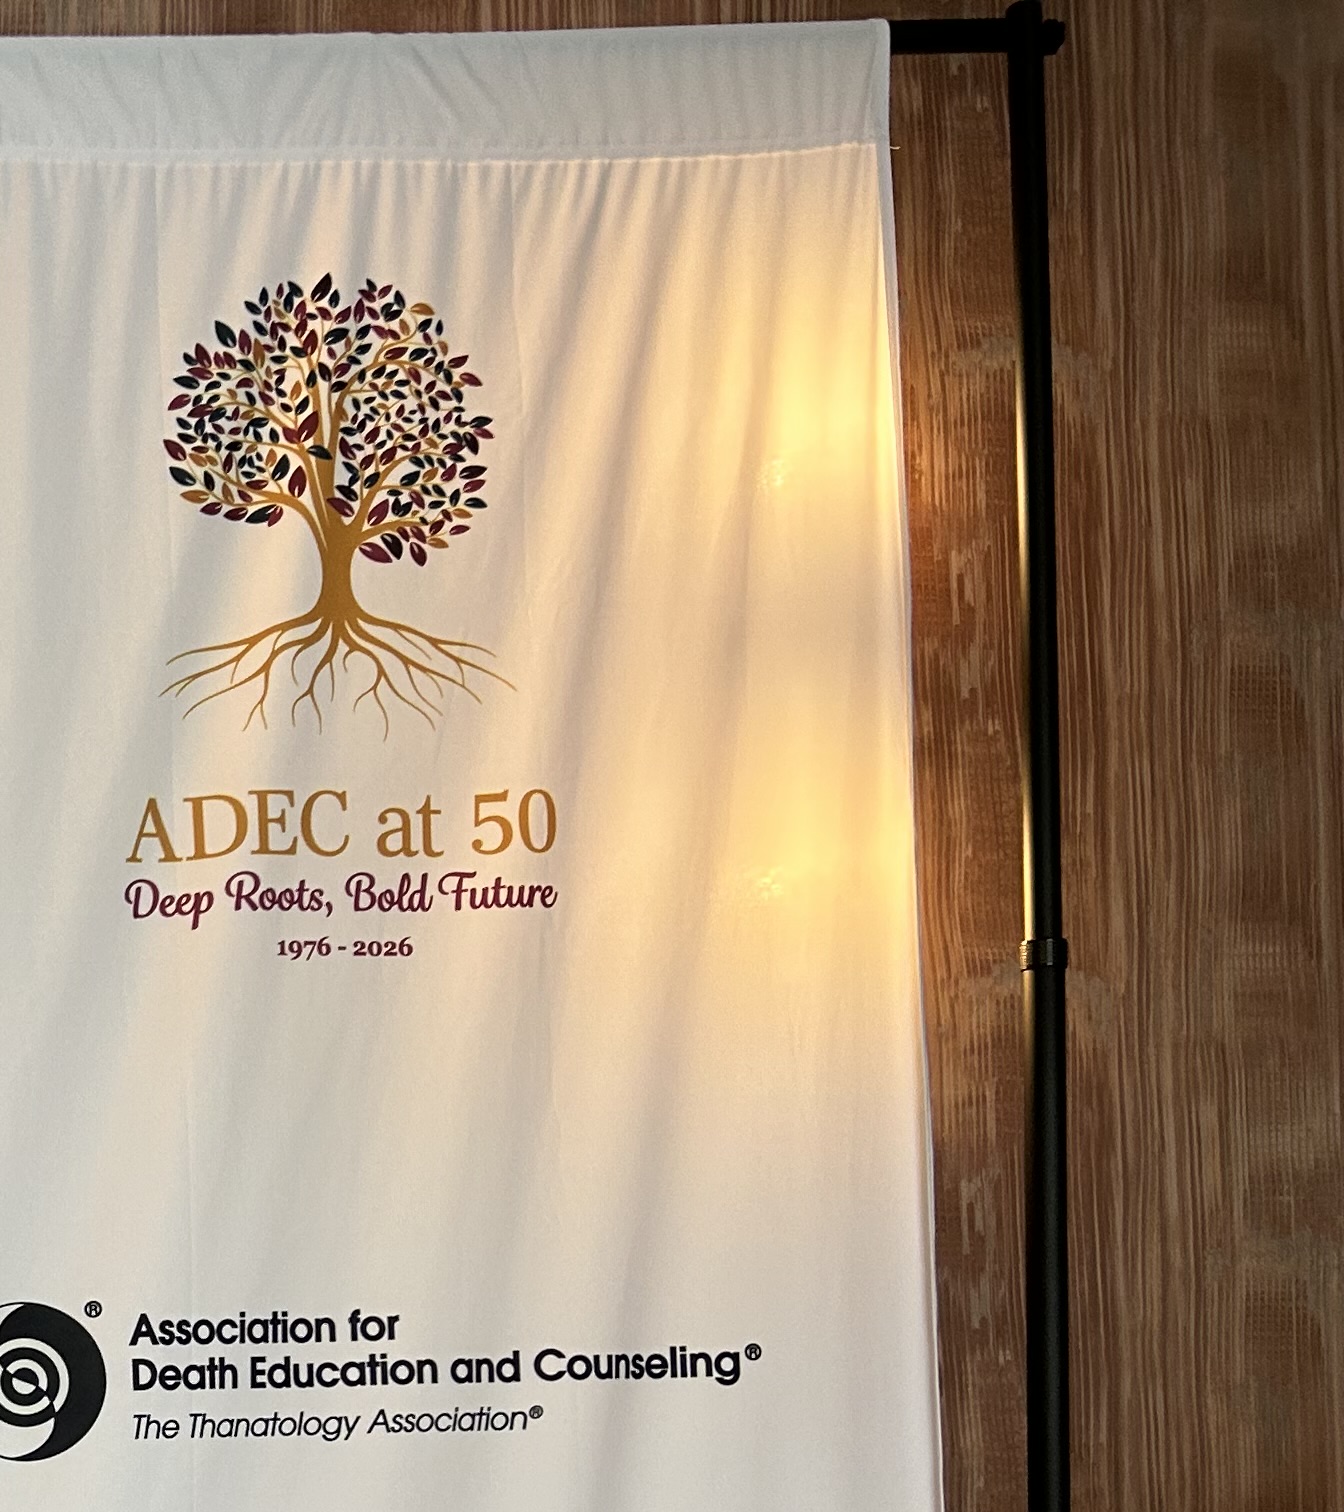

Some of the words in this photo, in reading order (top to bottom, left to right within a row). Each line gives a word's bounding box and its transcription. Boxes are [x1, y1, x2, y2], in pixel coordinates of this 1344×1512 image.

[126, 790, 349, 863] ADEC
[377, 795, 444, 858] at
[472, 789, 556, 855] 50
[124, 879, 214, 930] Deep
[225, 871, 333, 917] Roots,
[345, 872, 433, 912] Bold
[438, 871, 558, 911] Future
[278, 936, 331, 961] 1976
[353, 936, 413, 957] 2026
[129, 1311, 336, 1346] Association
[348, 1309, 400, 1342] for
[132, 1357, 238, 1391] Death
[250, 1353, 438, 1389] Education
[450, 1350, 521, 1384] and
[133, 1414, 180, 1440] The
[189, 1411, 361, 1442] Thanatology
